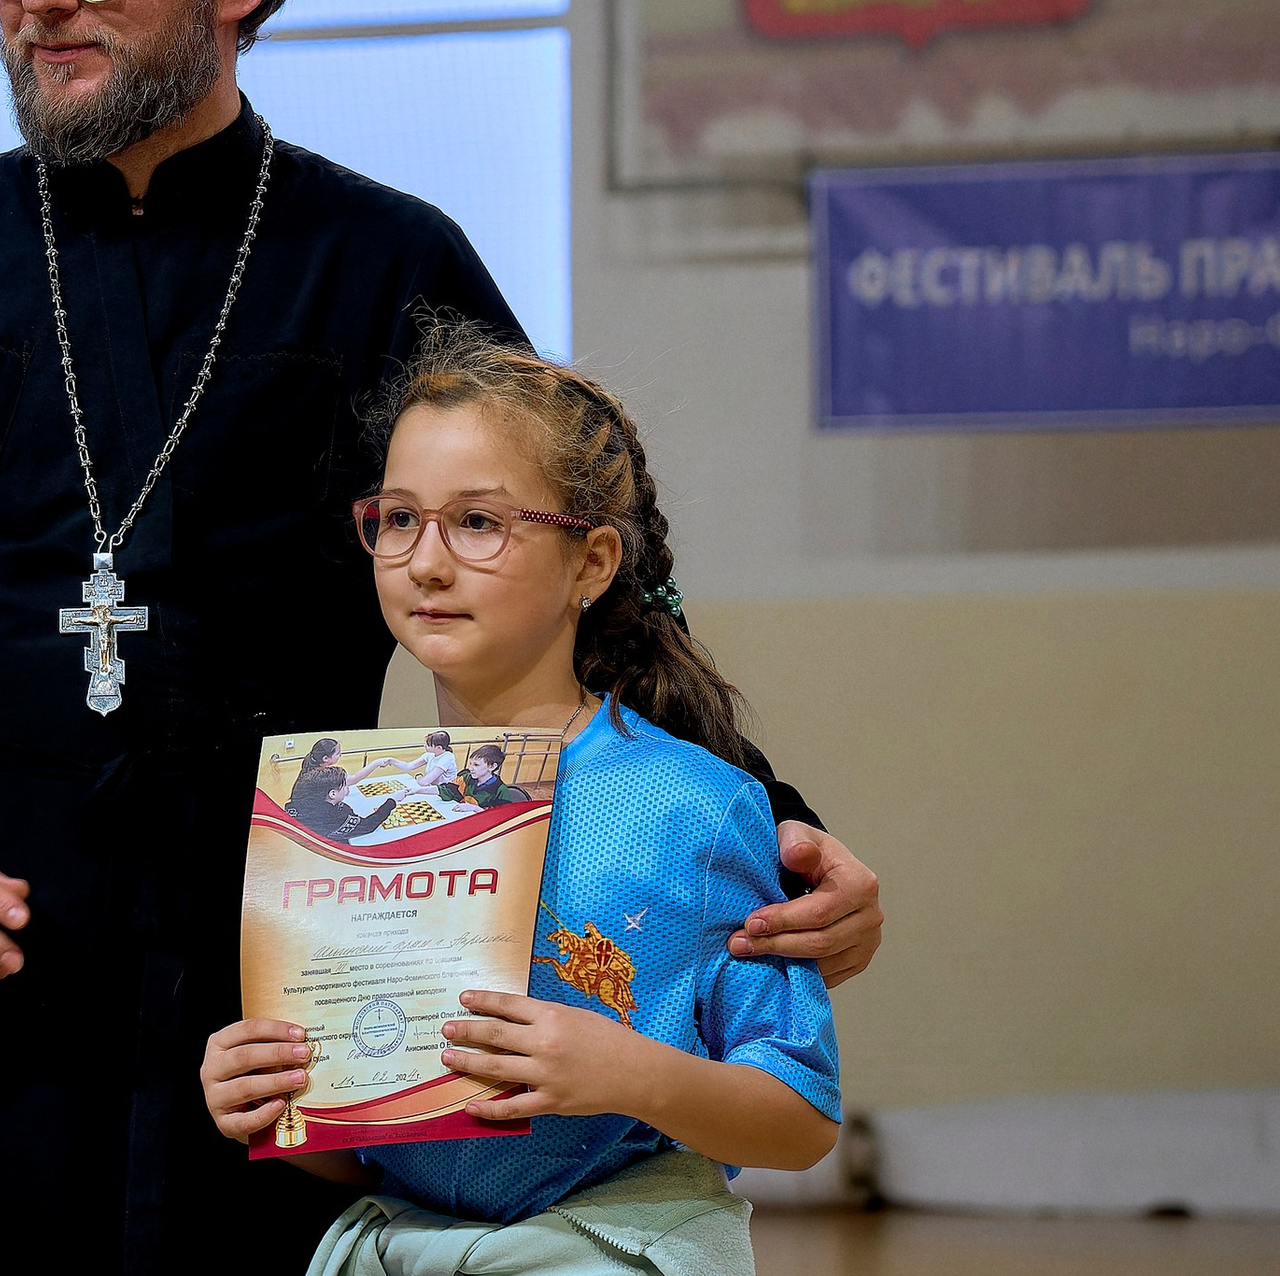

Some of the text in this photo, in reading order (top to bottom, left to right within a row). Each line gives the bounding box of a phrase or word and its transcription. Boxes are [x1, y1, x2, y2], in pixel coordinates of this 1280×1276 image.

[848, 240, 1173, 308] ФЕСТИВАЛЬ
[282, 868, 499, 910] ГРАМОТА
[350, 909, 418, 923] НАГРАЖДАЕТСЯ
[356, 928, 409, 939] команда прихода
[300, 967, 332, 977] занявшая
[349, 964, 369, 972] место
[375, 959, 424, 971] соревнованиях
[434, 955, 463, 964] шашкам
[283, 981, 352, 995] Культурно-спортивного
[352, 977, 386, 989] фестиваля
[386, 972, 441, 985] Наро-Фоминского
[314, 986, 447, 1007] посвященного Дню православной молодежи
[440, 1010, 456, 1019] Олег
[405, 1042, 439, 1053] Анисимова
